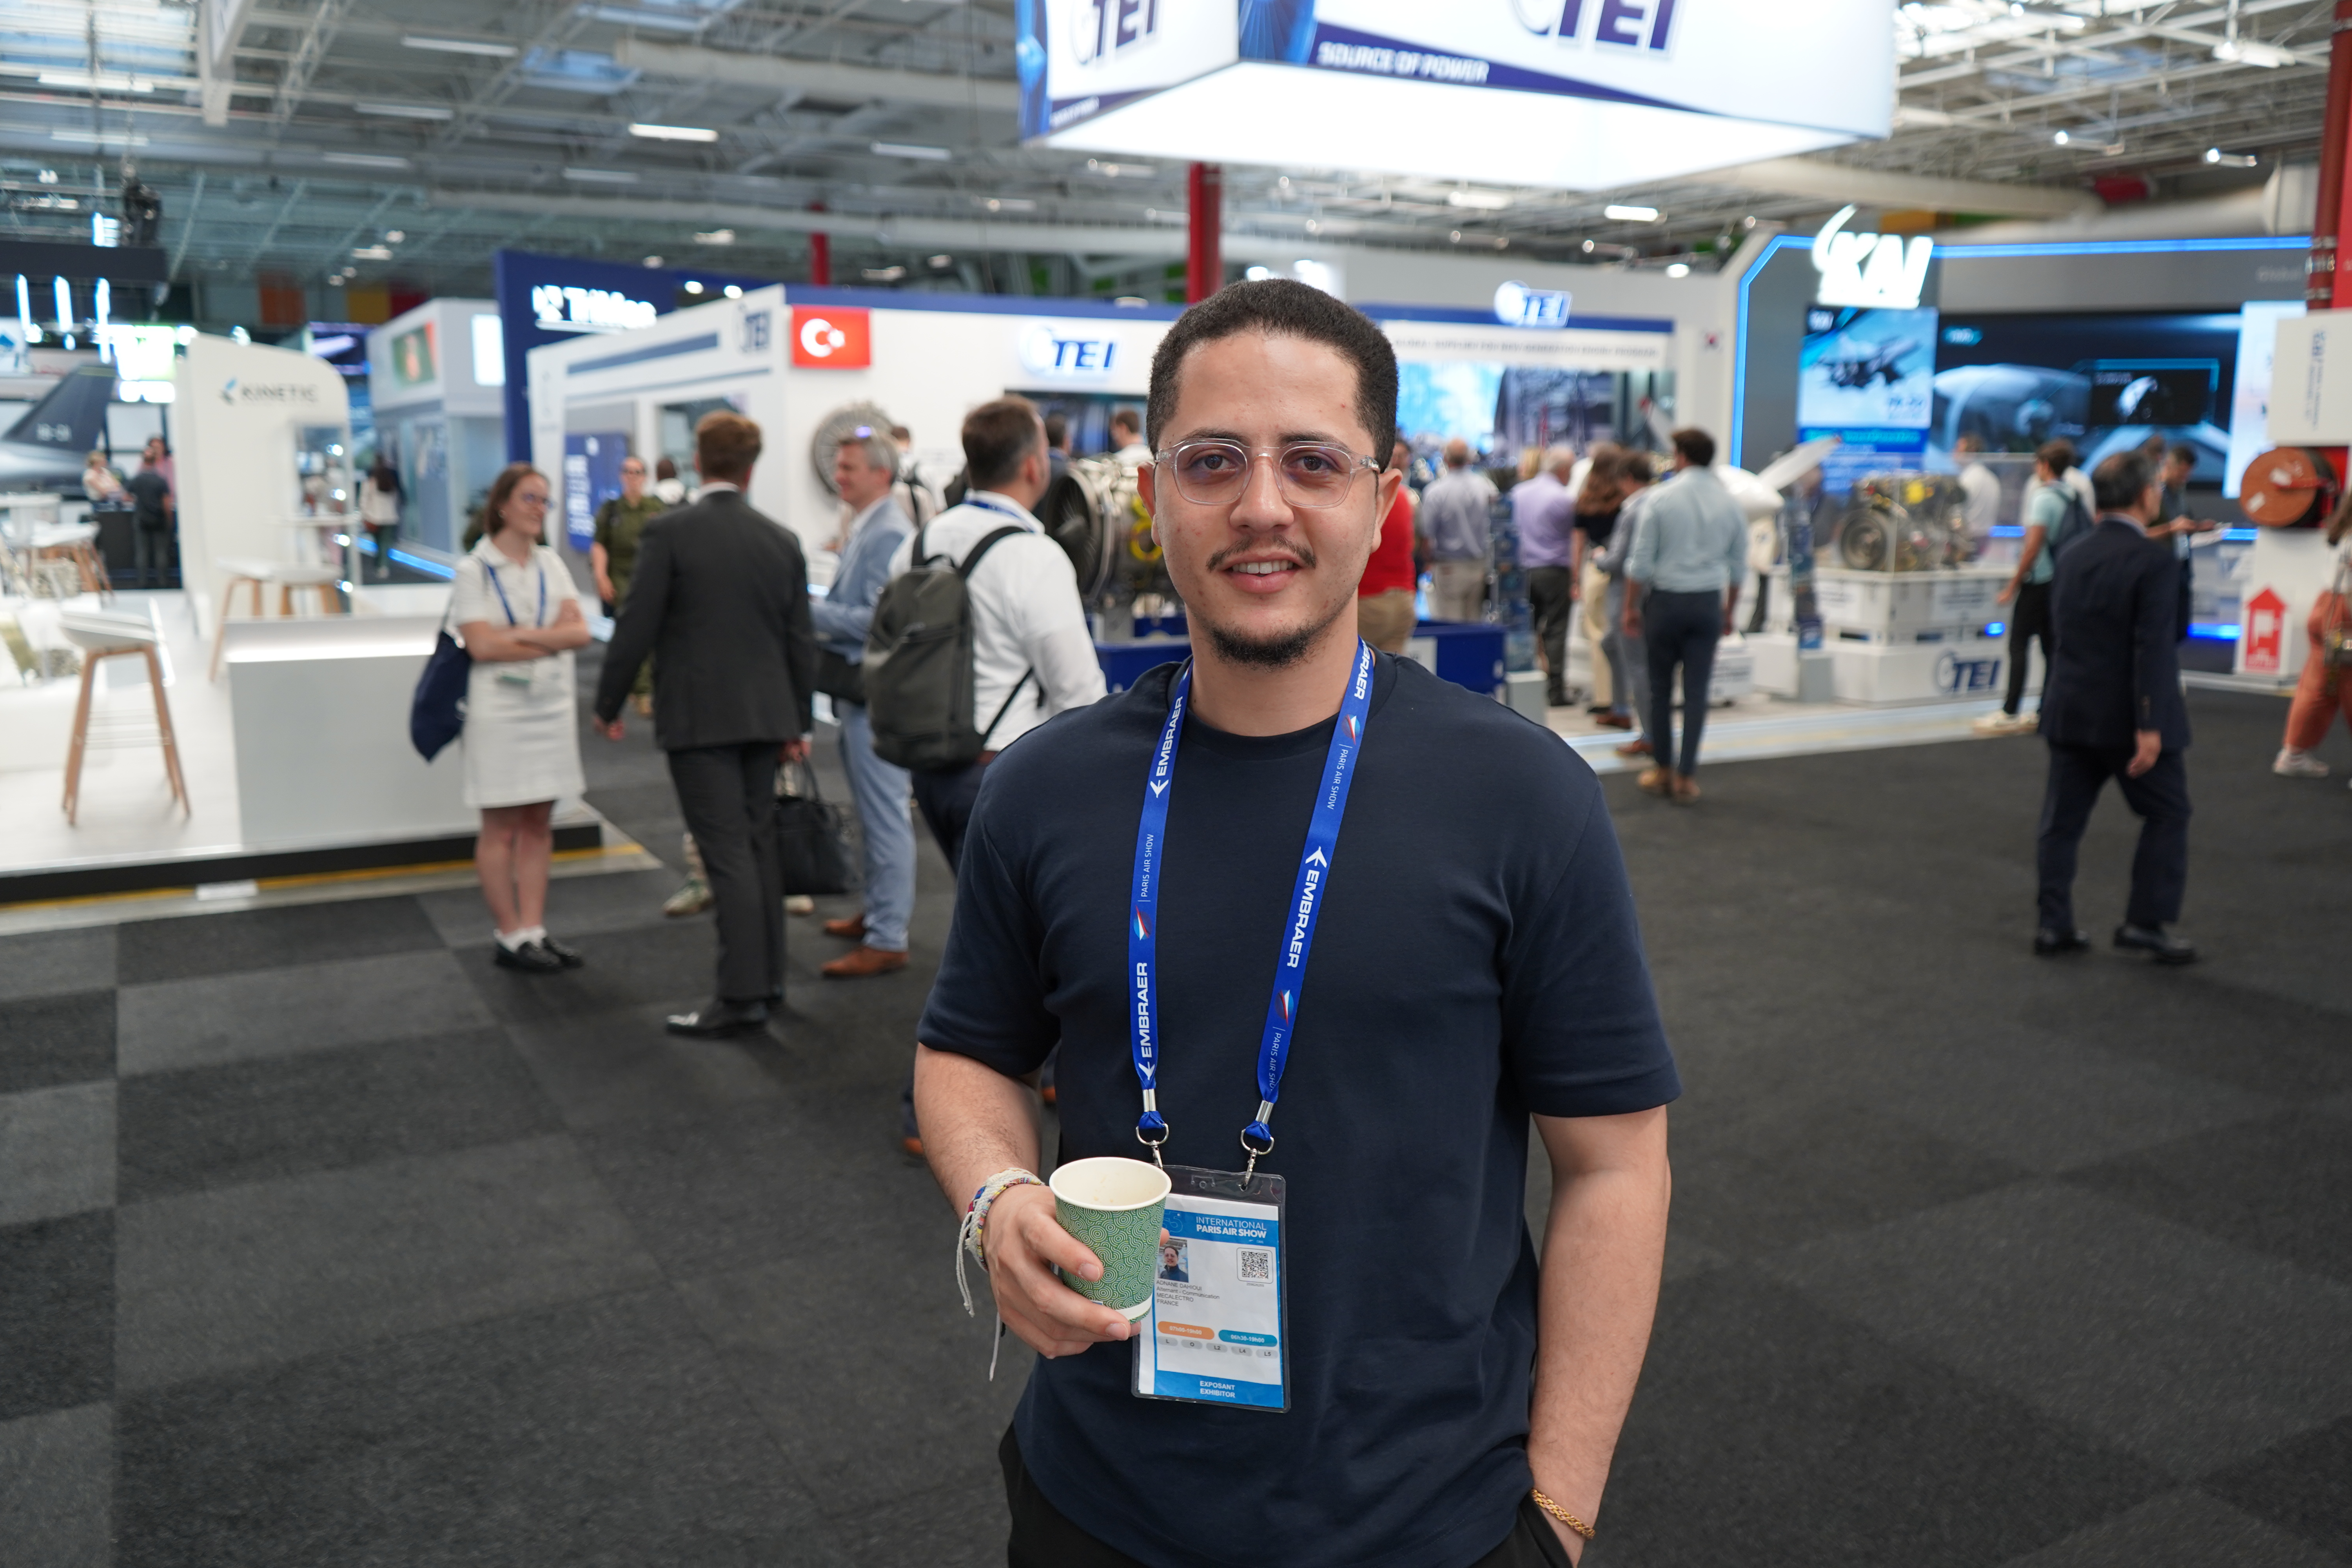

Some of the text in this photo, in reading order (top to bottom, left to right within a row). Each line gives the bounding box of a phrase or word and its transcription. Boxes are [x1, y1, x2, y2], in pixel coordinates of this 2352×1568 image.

[1317, 40, 1490, 84] SOURCE OF POWER
[242, 383, 319, 402] KINETIC
[1156, 696, 1183, 777] EMBRAER
[1327, 749, 1348, 809] PARIS AIR SHOW
[1144, 834, 1154, 857] SHOW
[1141, 874, 1149, 897] PARIS
[1287, 869, 1320, 968] EMBRAER
[1137, 962, 1152, 1058] EMBRAER
[1270, 1033, 1281, 1056] PARIS
[1196, 1216, 1267, 1230] INTERNATIONAL
[1196, 1224, 1267, 1238] PARIS AIR SHOW
[1157, 1293, 1194, 1302] MECALECTRO
[1182, 1290, 1220, 1299] Communication
[1200, 1381, 1235, 1390] EXPOSANT
[1200, 1388, 1236, 1398] EXHIBITOR
